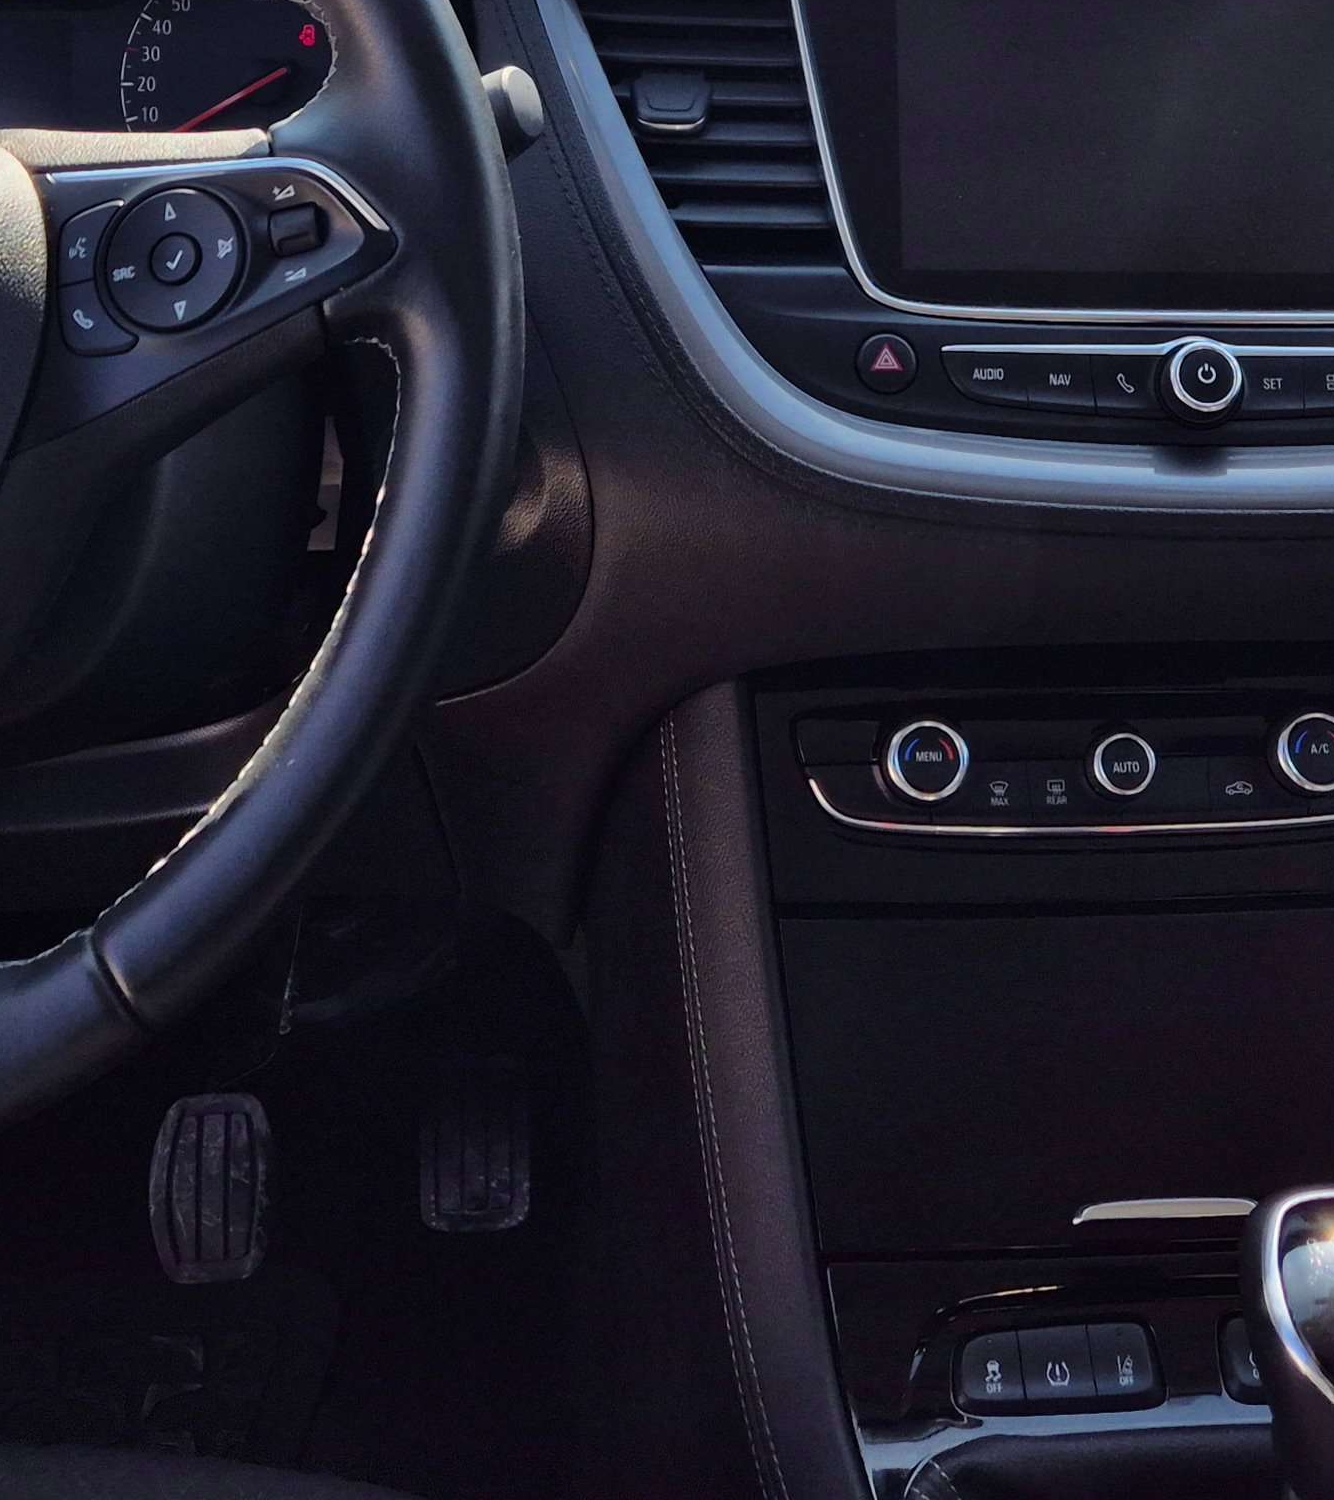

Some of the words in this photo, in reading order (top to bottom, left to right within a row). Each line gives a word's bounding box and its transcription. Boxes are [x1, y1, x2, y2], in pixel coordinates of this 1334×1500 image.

[152, 19, 173, 36] 40
[141, 45, 161, 62] 30
[137, 76, 157, 92] 20
[142, 106, 160, 123] 10
[112, 265, 136, 282] SRC
[972, 367, 1004, 381] AUDIO
[1049, 372, 1072, 387] NAV
[1263, 377, 1283, 391] SET
[1310, 743, 1330, 754] A/C
[916, 750, 942, 763] MENU
[1113, 760, 1140, 774] AUTO
[990, 796, 1010, 807] MAX
[1046, 794, 1068, 806] REAR
[1119, 1373, 1135, 1387] OFF
[985, 1381, 1003, 1394] OFF
